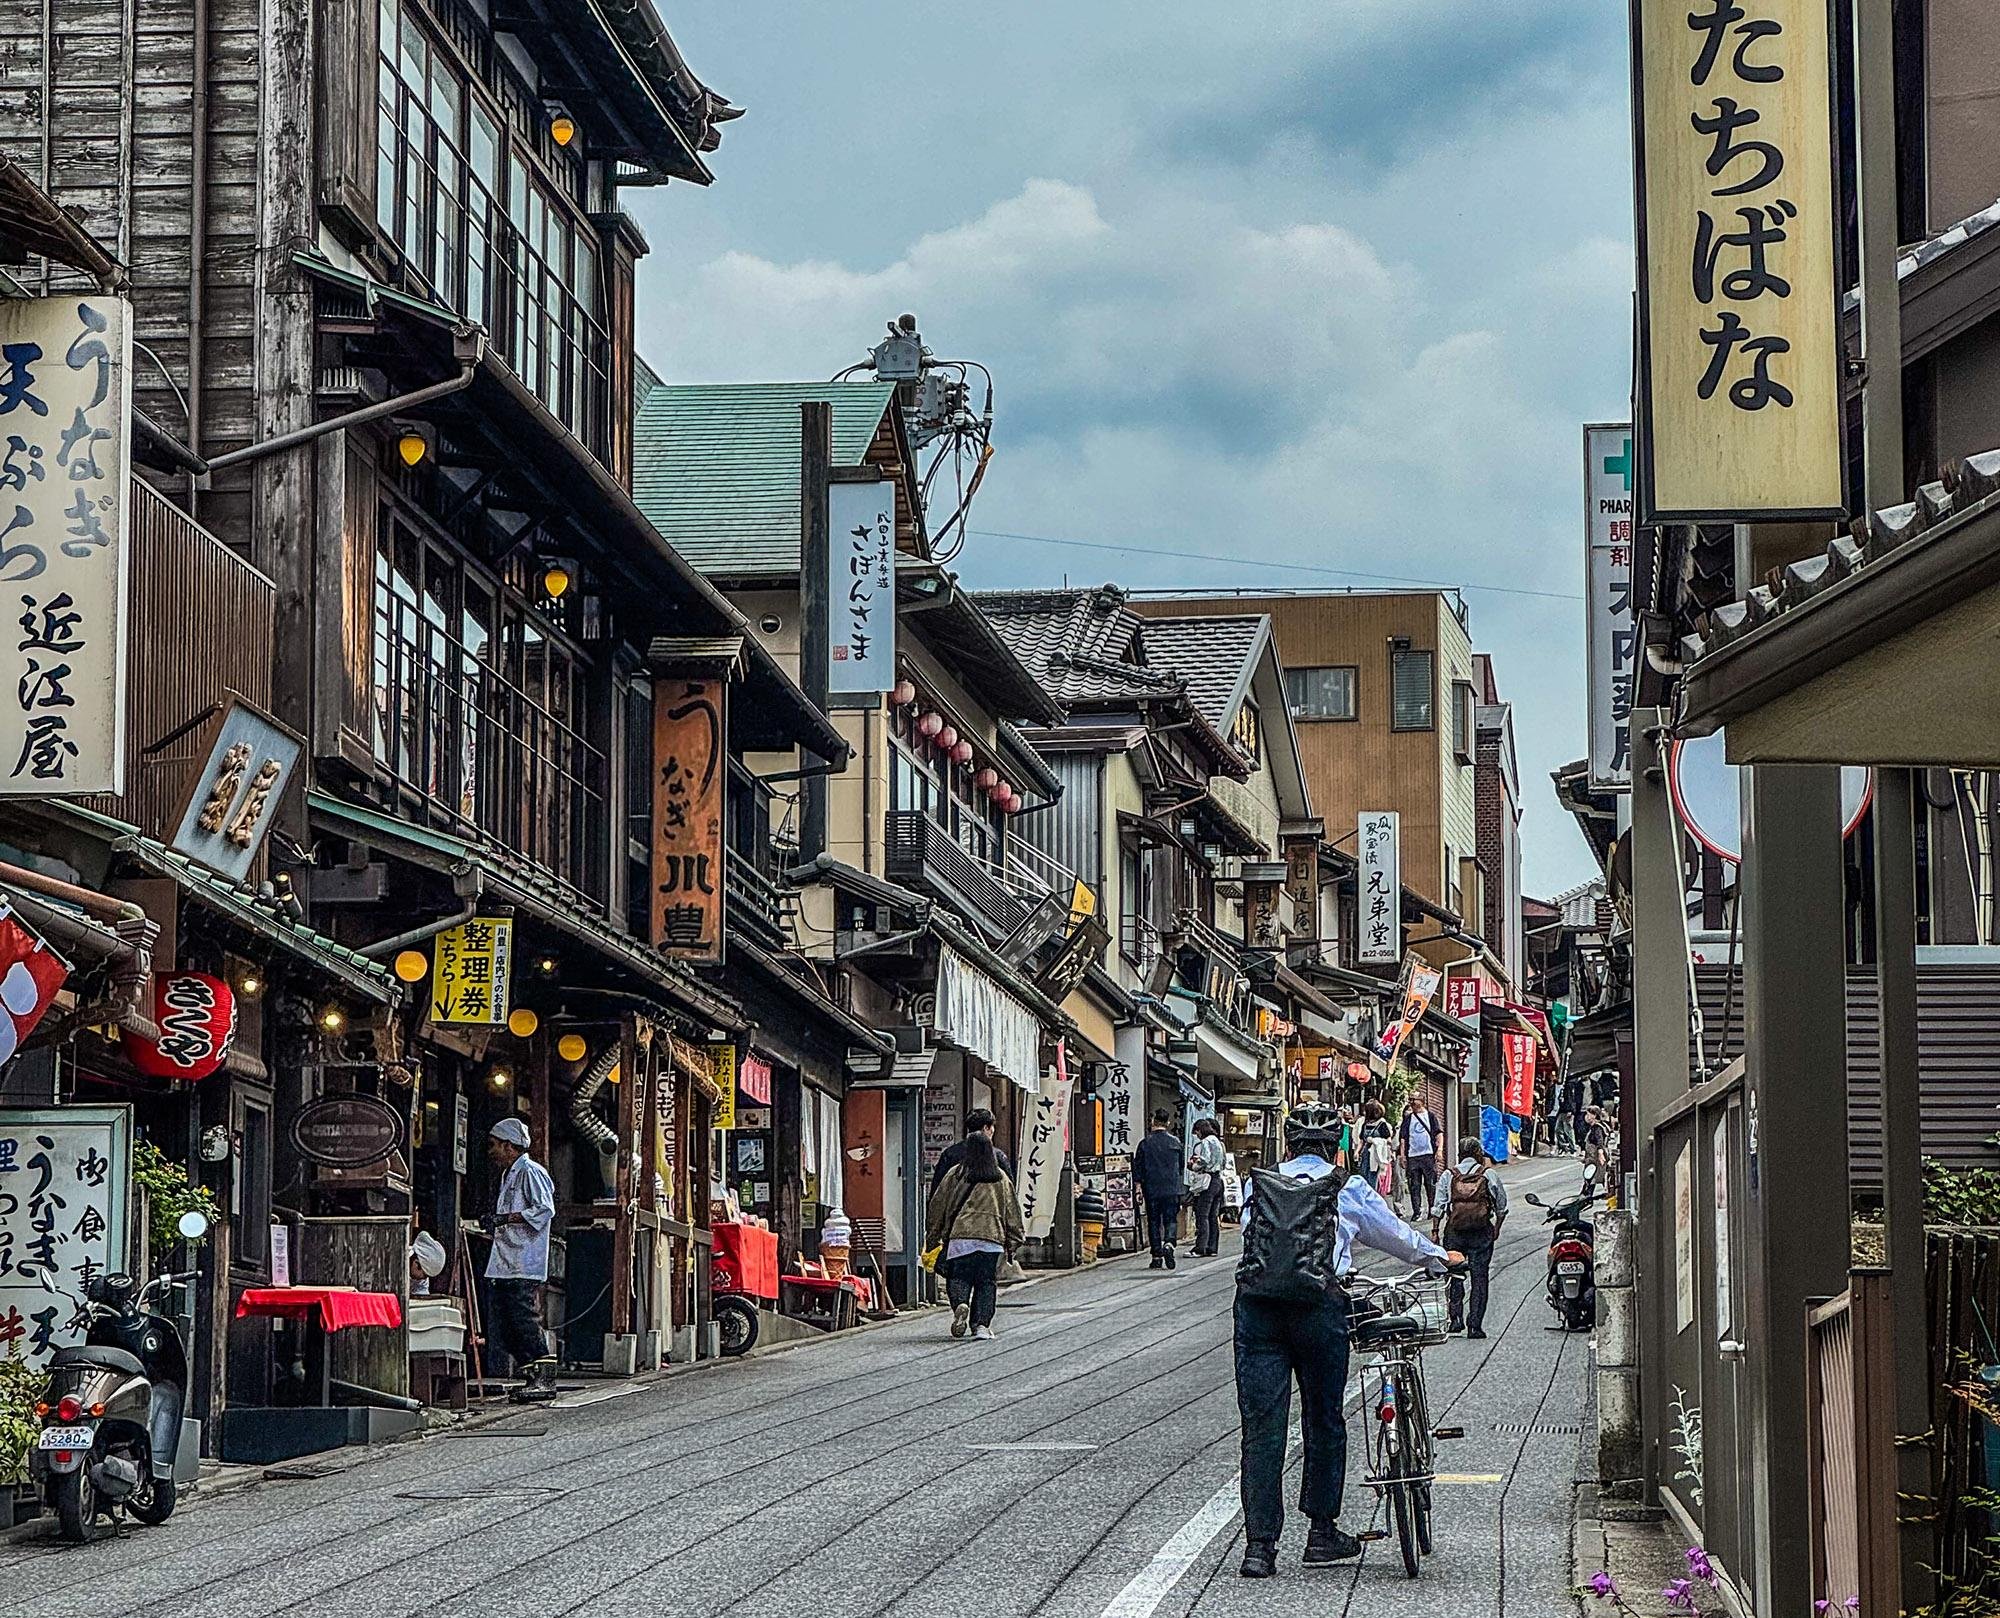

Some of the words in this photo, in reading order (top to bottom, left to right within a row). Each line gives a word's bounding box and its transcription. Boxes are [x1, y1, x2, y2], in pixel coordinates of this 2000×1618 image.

[1687, 0, 1797, 412] たちばな
[0, 341, 49, 582] 天ぷら
[56, 302, 114, 558] うなぎ
[849, 524, 877, 662] さぼんさま
[1609, 521, 1632, 567] 調剤
[9, 592, 87, 780] 近江屋
[661, 682, 721, 840] うなぎ
[1376, 815, 1392, 842] 瓜の
[441, 926, 457, 983] こちら
[658, 853, 715, 952] 川豊
[1366, 870, 1391, 948] 兄弟堂
[459, 921, 493, 1017] 整理券
[1022, 1095, 1056, 1219] さぼんさま
[1107, 1062, 1131, 1157] 京増漬
[17, 1135, 68, 1278] うなぎ
[50, 1433, 81, 1444] 5280
